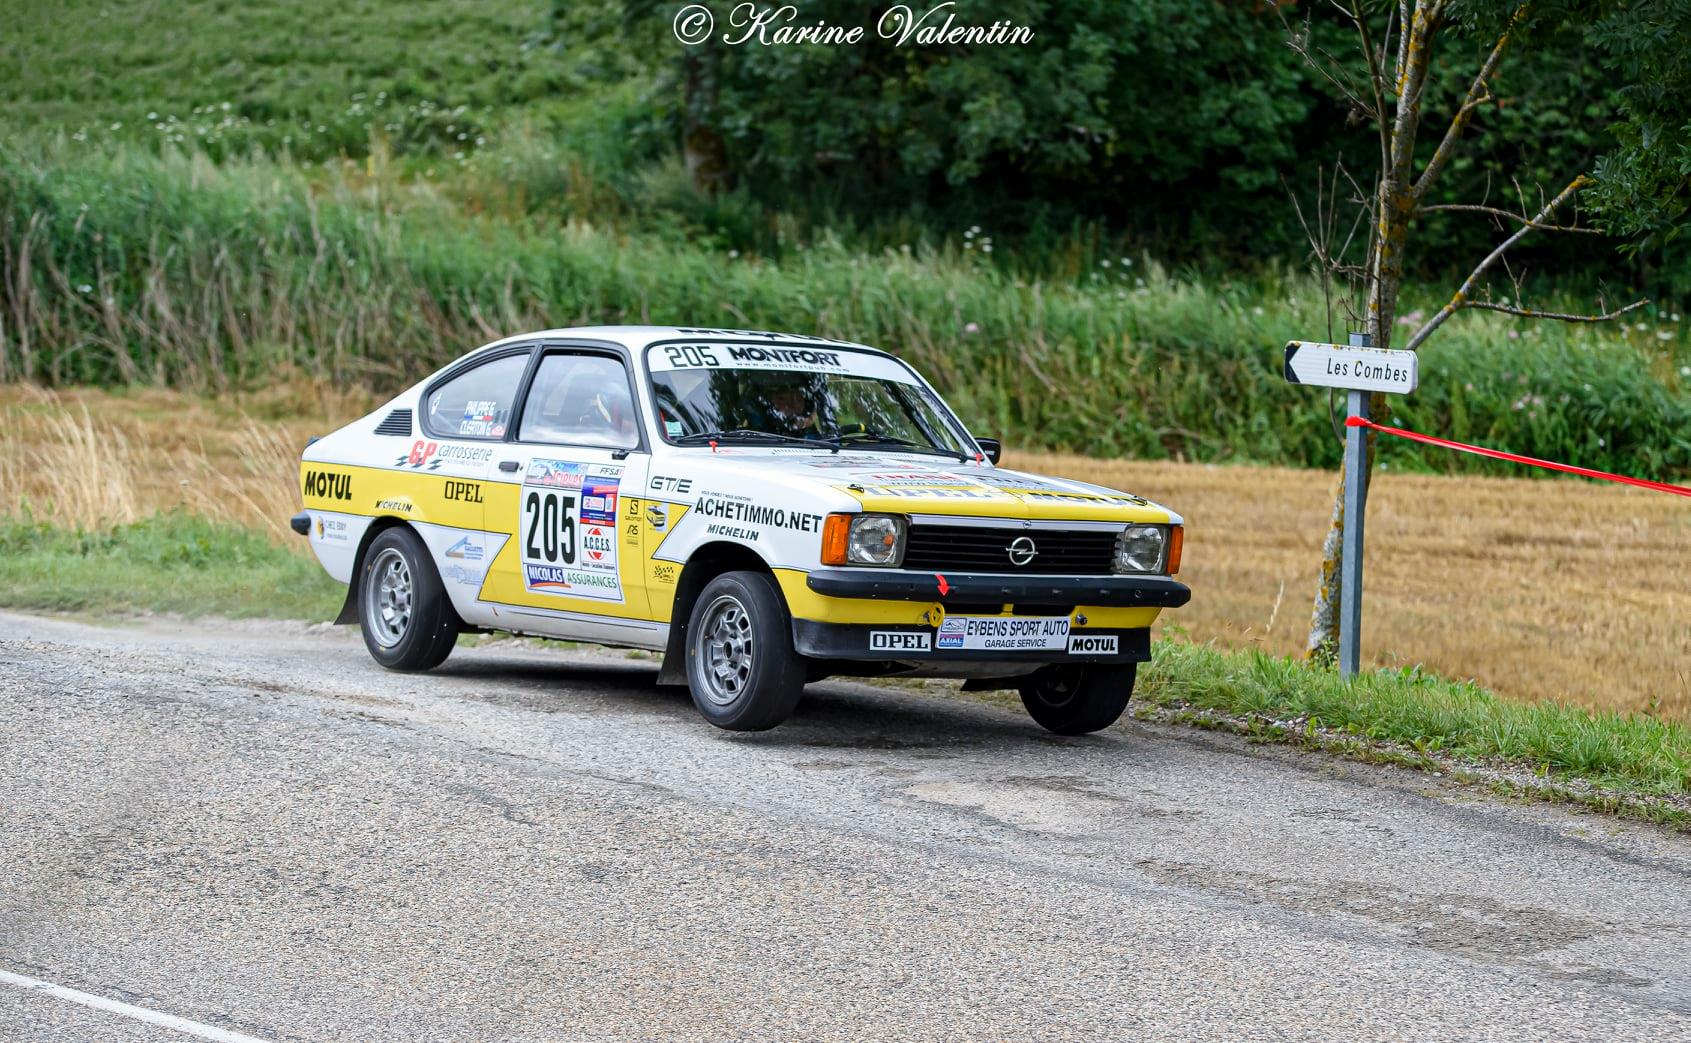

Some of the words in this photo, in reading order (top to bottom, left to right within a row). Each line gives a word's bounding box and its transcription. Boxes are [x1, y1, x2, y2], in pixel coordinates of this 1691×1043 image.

[664, 346, 720, 368] 205
[727, 346, 842, 366] MONTFORT
[1326, 357, 1349, 376] Les
[1354, 360, 1408, 383] Combes
[408, 440, 438, 465] GP
[438, 444, 493, 462] carrosserie
[599, 467, 620, 476] FFSA
[304, 470, 353, 501] MOTUL
[444, 480, 484, 504] OPEL
[650, 475, 693, 494] GT/E
[694, 497, 823, 534] ACHETIMMO.NET
[526, 491, 576, 565] 205
[706, 523, 760, 542] MICHELIN
[583, 536, 612, 552] A.C.C.E.S.
[528, 565, 564, 583] NICOLAS
[566, 571, 618, 590] ASSURANCES
[966, 620, 1008, 637] EYBENS
[1009, 620, 1042, 637] SPORT
[1041, 620, 1069, 636] AUTO
[872, 633, 929, 650] OPEL
[940, 637, 963, 645] AXIAL
[984, 638, 1015, 648] GARAGE
[1016, 638, 1047, 648] SERVICE
[1071, 637, 1117, 652] MOTUL
